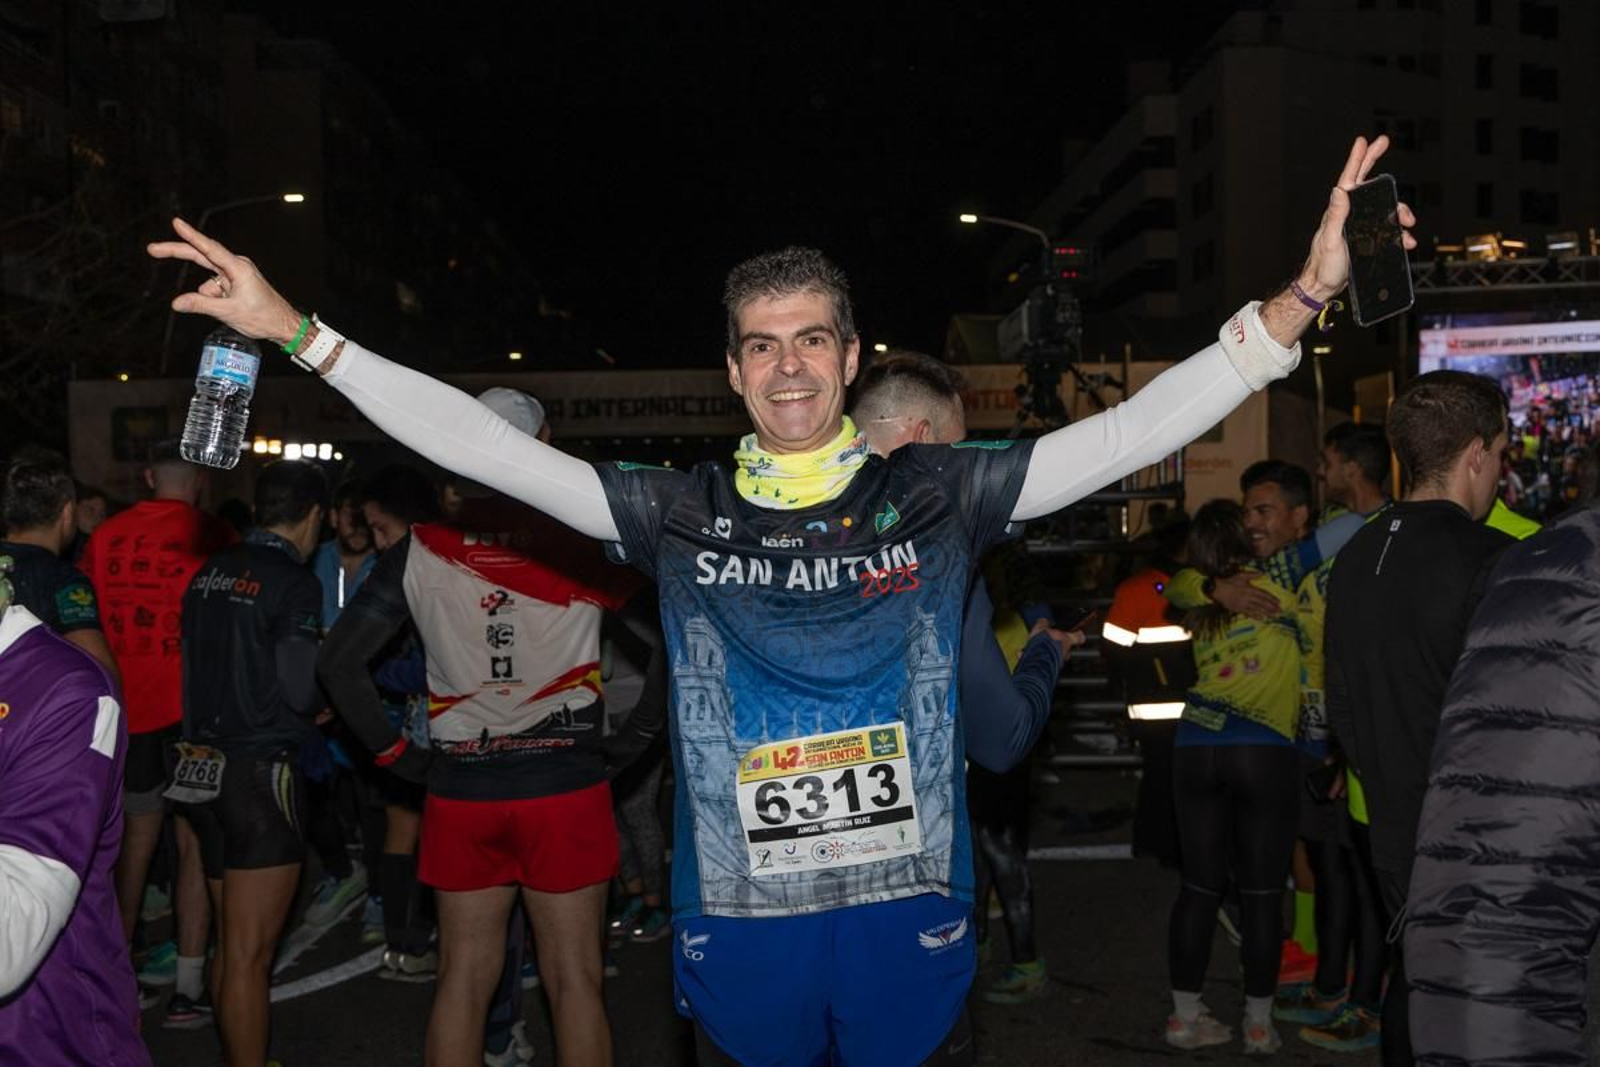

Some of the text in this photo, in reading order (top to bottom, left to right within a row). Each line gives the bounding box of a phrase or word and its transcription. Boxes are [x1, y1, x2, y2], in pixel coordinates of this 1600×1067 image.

[696, 550, 772, 585] SAN
[858, 563, 919, 598] 2025
[805, 752, 829, 764] SAN
[755, 763, 900, 825] 6313
[797, 823, 821, 835] ANGEL
[854, 815, 871, 825] RUIZ
